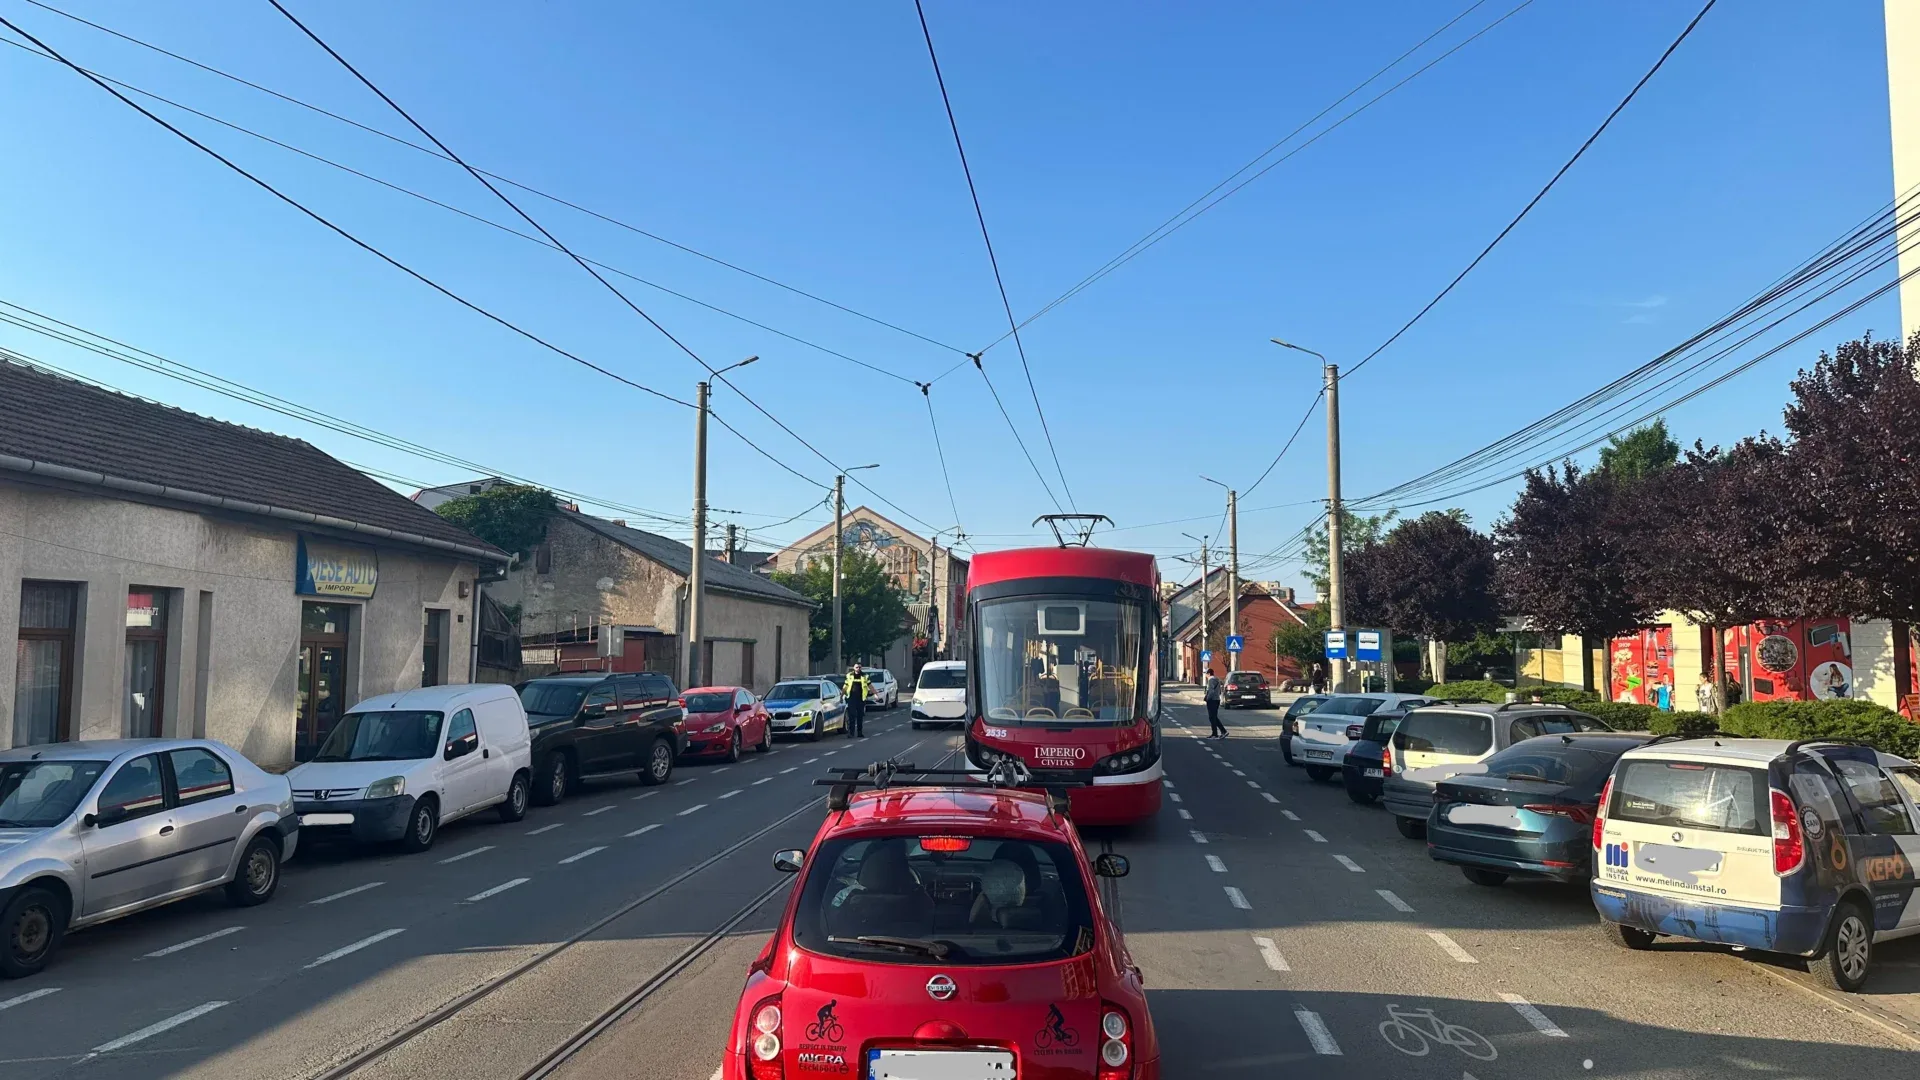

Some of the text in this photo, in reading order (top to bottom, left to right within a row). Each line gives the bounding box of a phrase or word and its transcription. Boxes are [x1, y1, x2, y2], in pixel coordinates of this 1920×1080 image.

[306, 557, 377, 585] PIESE AUTO
[324, 584, 355, 592] IMPORT
[985, 728, 1007, 738] 2535
[1034, 747, 1086, 760] IMPERIO
[1605, 867, 1629, 876] MELINDA
[1606, 873, 1629, 881] INSTAL
[1635, 875, 1727, 895] www.melindainstal.ro
[799, 1053, 844, 1064] MICRA
